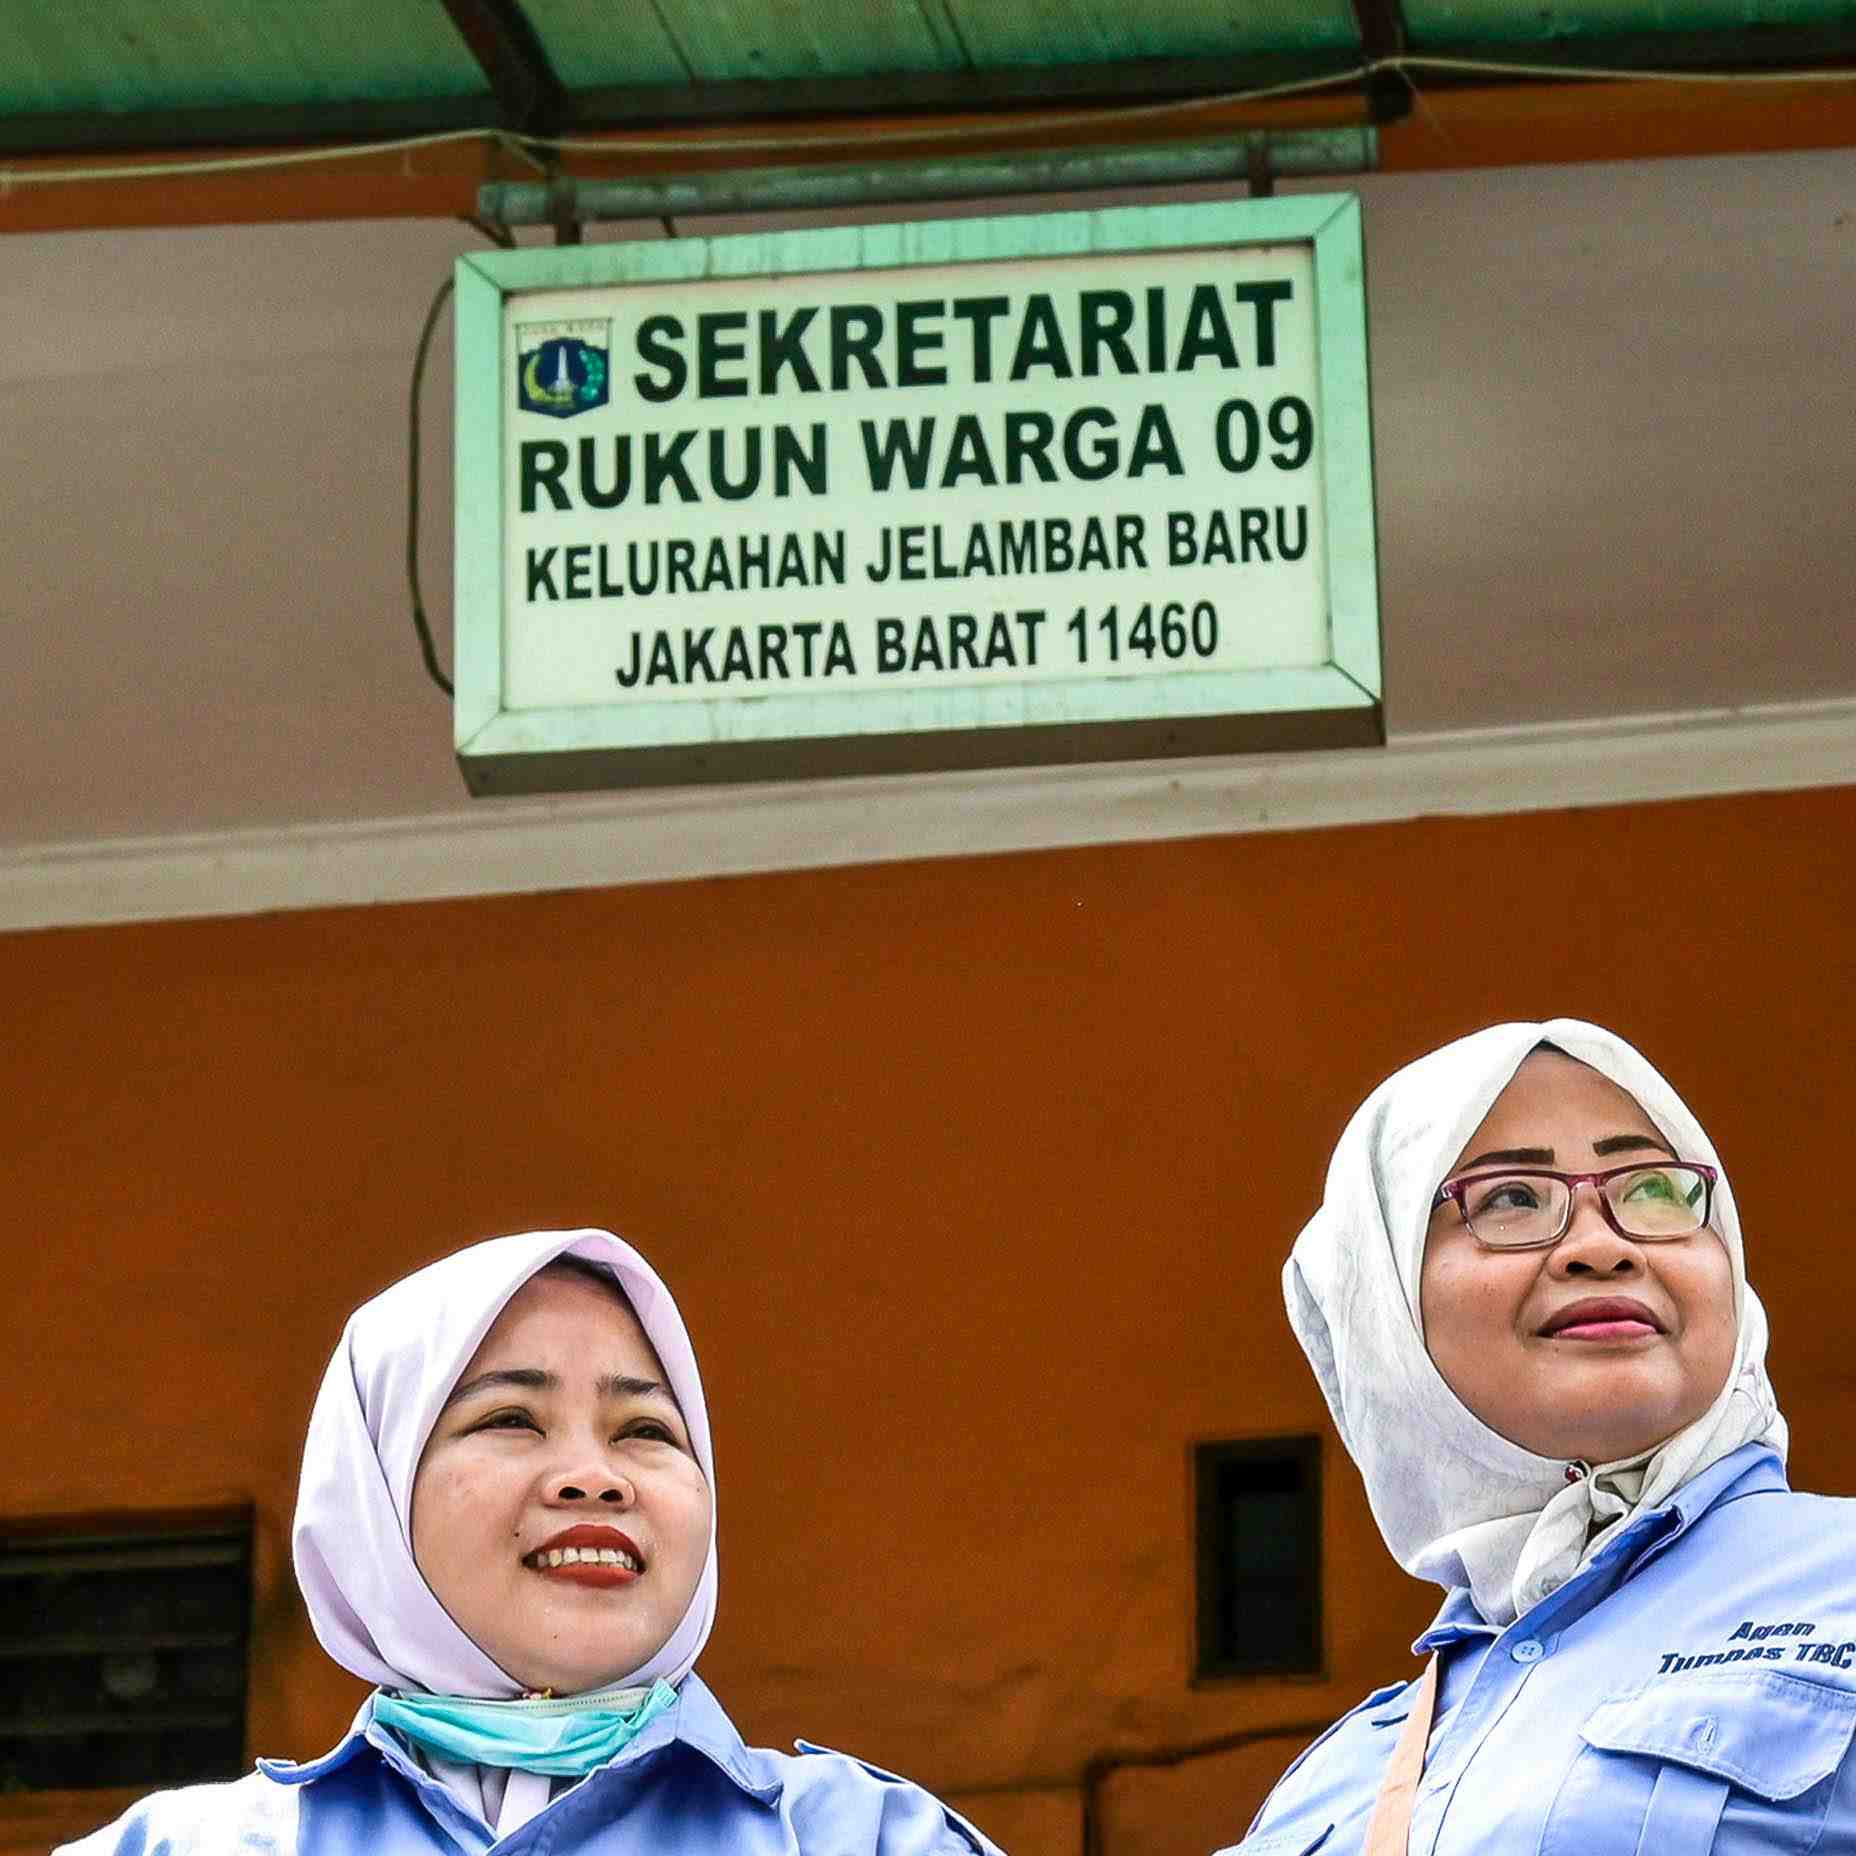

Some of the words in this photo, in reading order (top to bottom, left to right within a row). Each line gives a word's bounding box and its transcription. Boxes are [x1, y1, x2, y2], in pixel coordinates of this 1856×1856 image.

[633, 279, 1294, 403] SEKRETARIAT
[519, 422, 830, 513] RUKUN
[859, 405, 1185, 493] WARGA
[1215, 396, 1315, 474] 09
[526, 530, 846, 604] KELURAHAN
[866, 514, 1148, 585] JELAMBAR
[1166, 505, 1309, 569] BARU
[616, 621, 856, 688] JAKARTA
[877, 610, 1046, 676] BARAT
[1066, 600, 1219, 665] 11460
[1657, 1646, 1786, 1675] Tumpas
[1795, 1641, 1856, 1670] TBC
[1727, 1621, 1816, 1642] Agen
